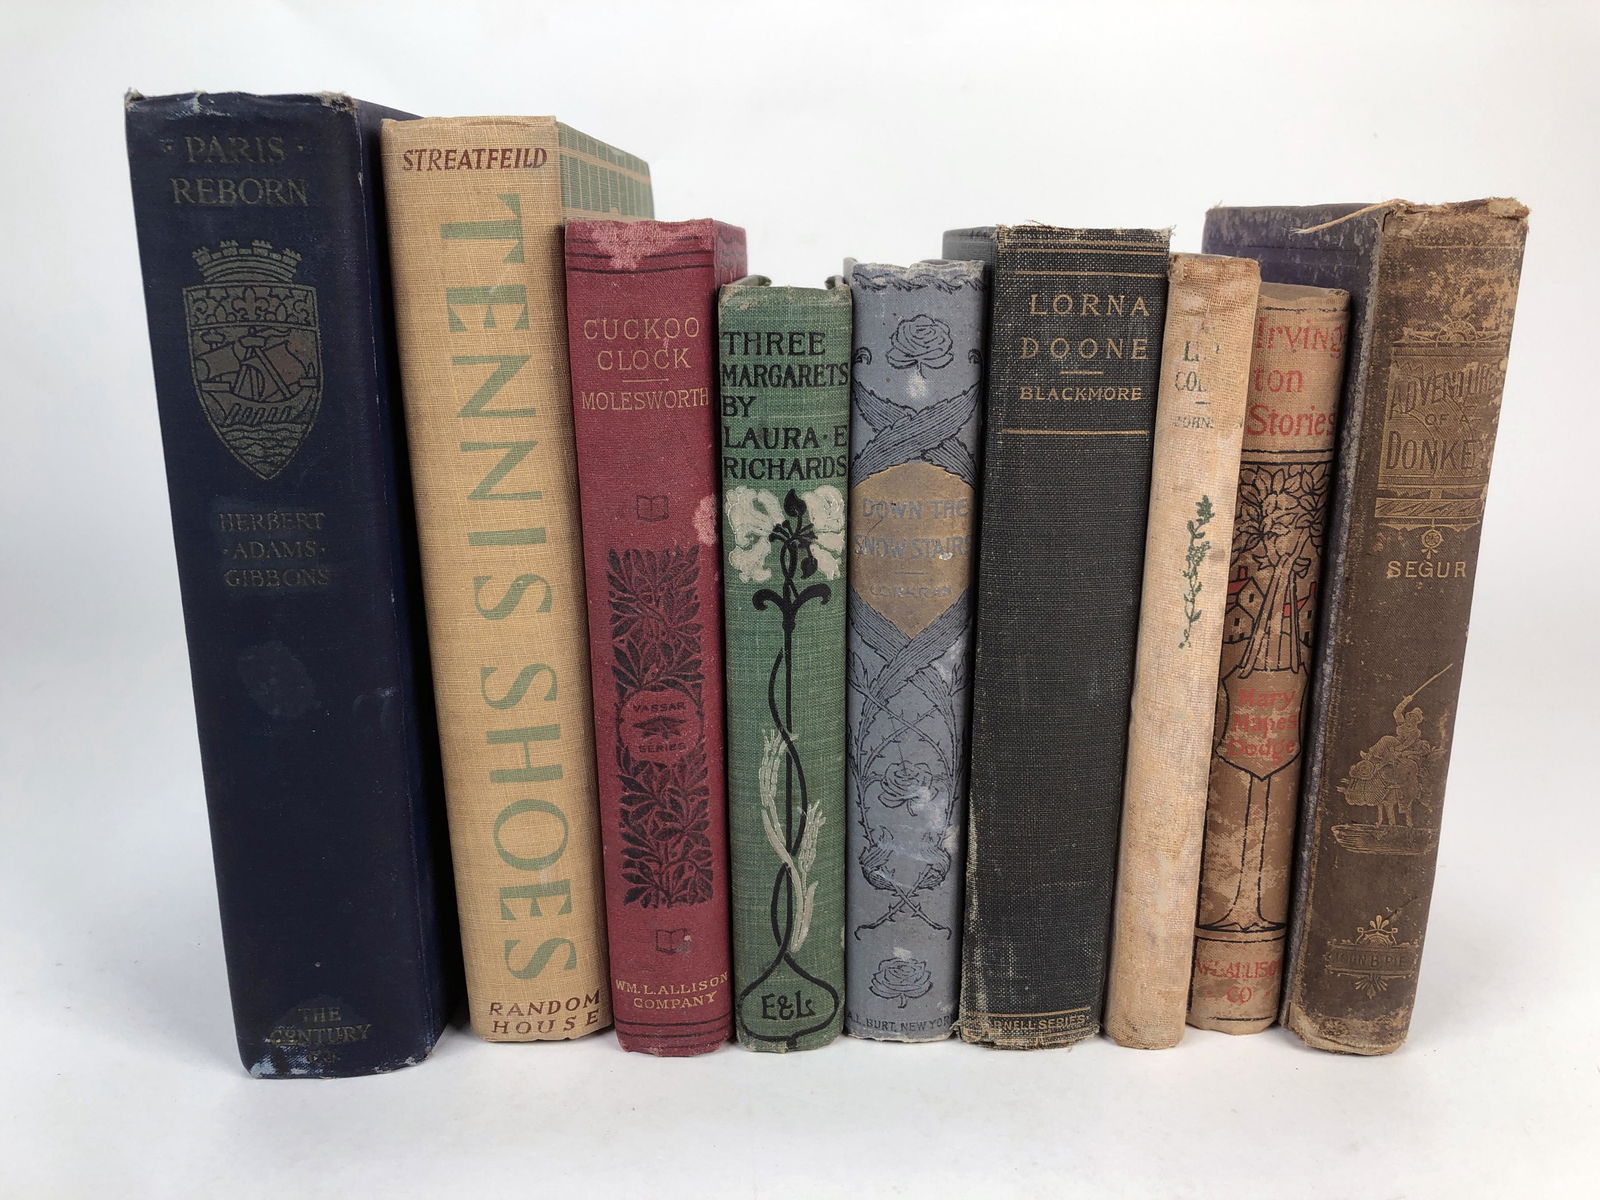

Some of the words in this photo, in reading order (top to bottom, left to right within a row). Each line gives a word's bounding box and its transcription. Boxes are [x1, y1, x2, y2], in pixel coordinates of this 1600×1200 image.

[184, 136, 289, 164] PARIS
[402, 147, 548, 172] STREATFEILD
[169, 177, 308, 207] REBORN
[1030, 293, 1150, 317] LORNA
[583, 317, 700, 340] CUCKOO
[722, 331, 826, 356] THREE
[1019, 337, 1149, 360] DOONE
[597, 347, 692, 371] CLOCK
[721, 362, 849, 388] MARGARETS
[1253, 365, 1303, 393] ton
[581, 388, 709, 411] MOLESWORTH
[1019, 386, 1142, 402] BLACKMORE
[438, 193, 554, 622] TENNIS
[722, 396, 757, 418] BY
[1246, 404, 1338, 437] Stories
[1424, 413, 1451, 426] OF
[723, 455, 848, 480] RICHARDS
[862, 497, 924, 520] DOWN
[930, 497, 969, 520] THE
[218, 511, 326, 532] HERBERT
[232, 540, 318, 560] ADAMS
[223, 569, 330, 588] GIBBONS
[1386, 560, 1468, 578] SEGUR
[632, 701, 687, 713] VASSAR
[1238, 687, 1297, 711] Mary
[1226, 738, 1298, 766] Dodge
[480, 663, 577, 980] SHOES
[488, 989, 600, 1016] RANDOM
[633, 990, 718, 1010] COMPANY
[297, 1006, 342, 1022] THE
[491, 1009, 599, 1035] HOUSE
[900, 1020, 928, 1032] NEW
[267, 1022, 373, 1047] CENTURY
